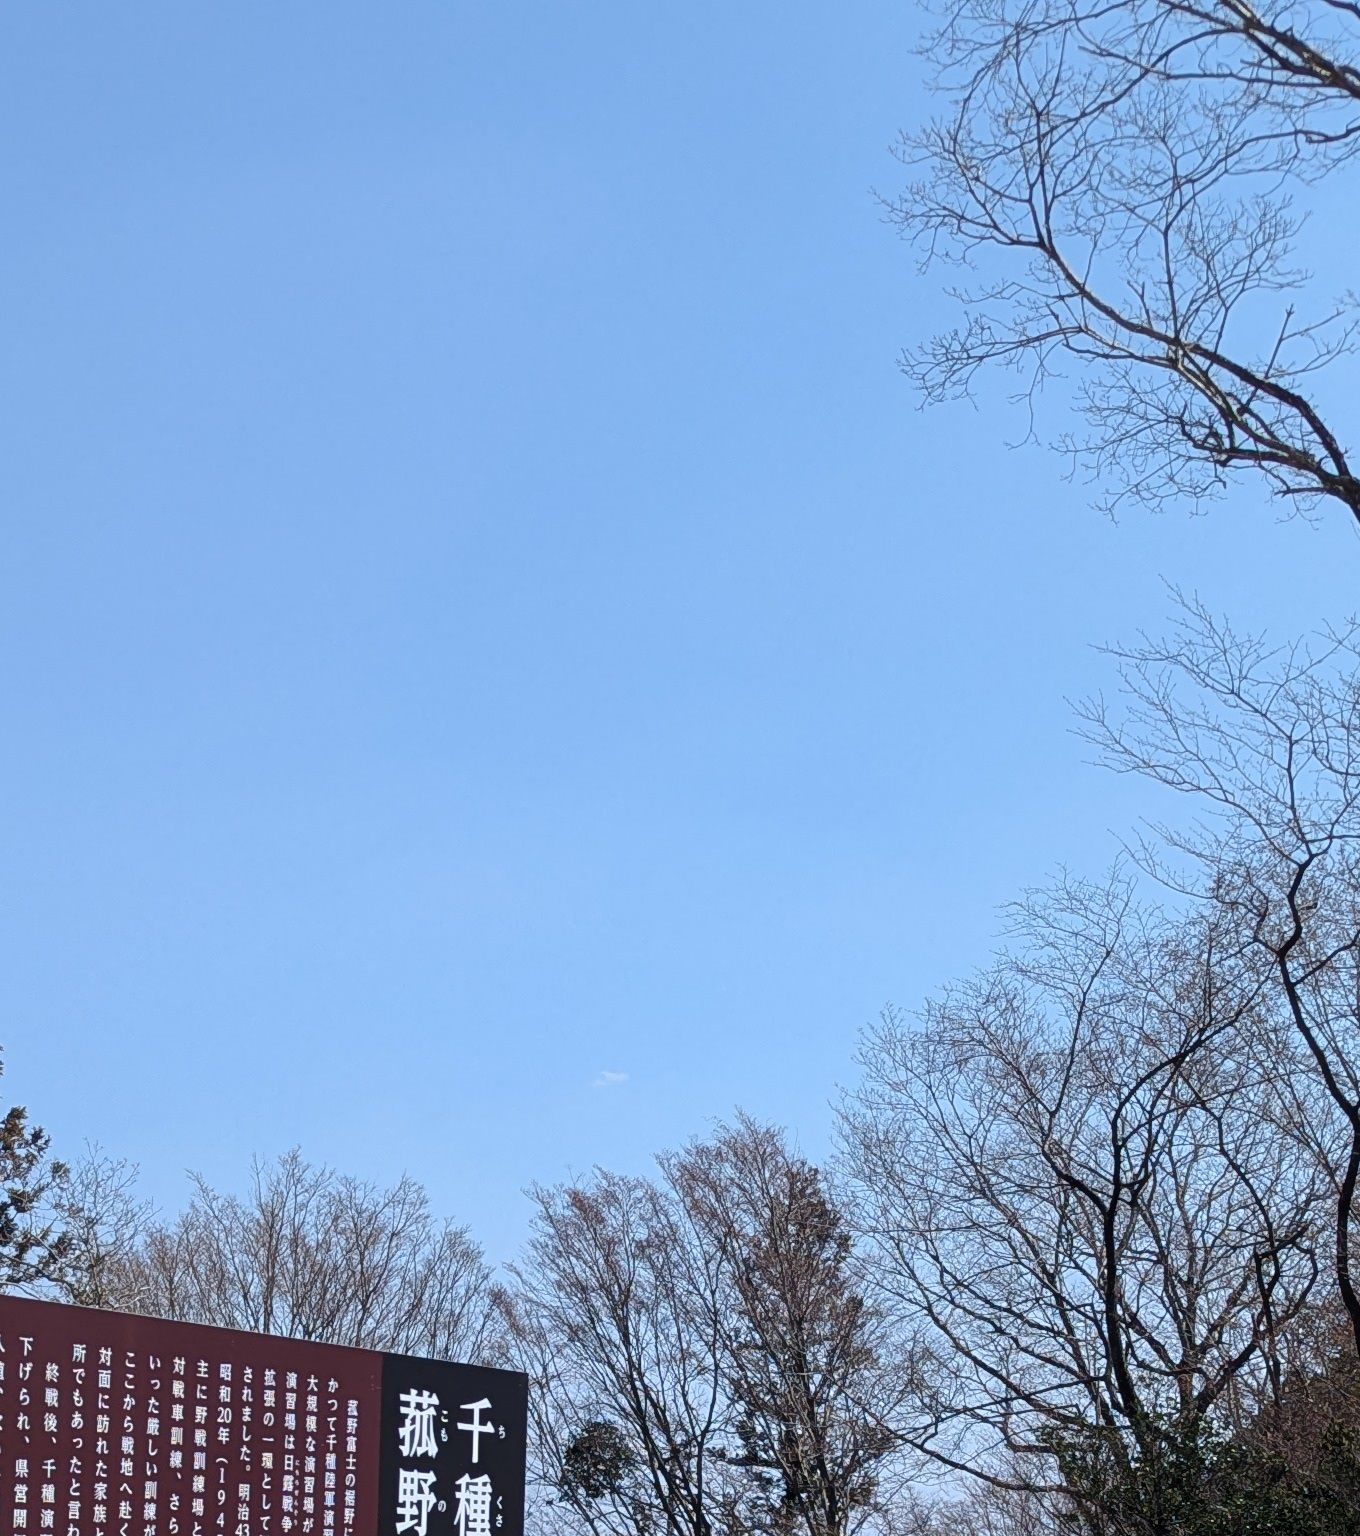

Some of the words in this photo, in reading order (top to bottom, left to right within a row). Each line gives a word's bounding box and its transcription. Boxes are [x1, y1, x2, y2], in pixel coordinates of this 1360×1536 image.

[498, 1425, 506, 1439] ち
[438, 1500, 446, 1513] の
[495, 1496, 503, 1528] くさ
